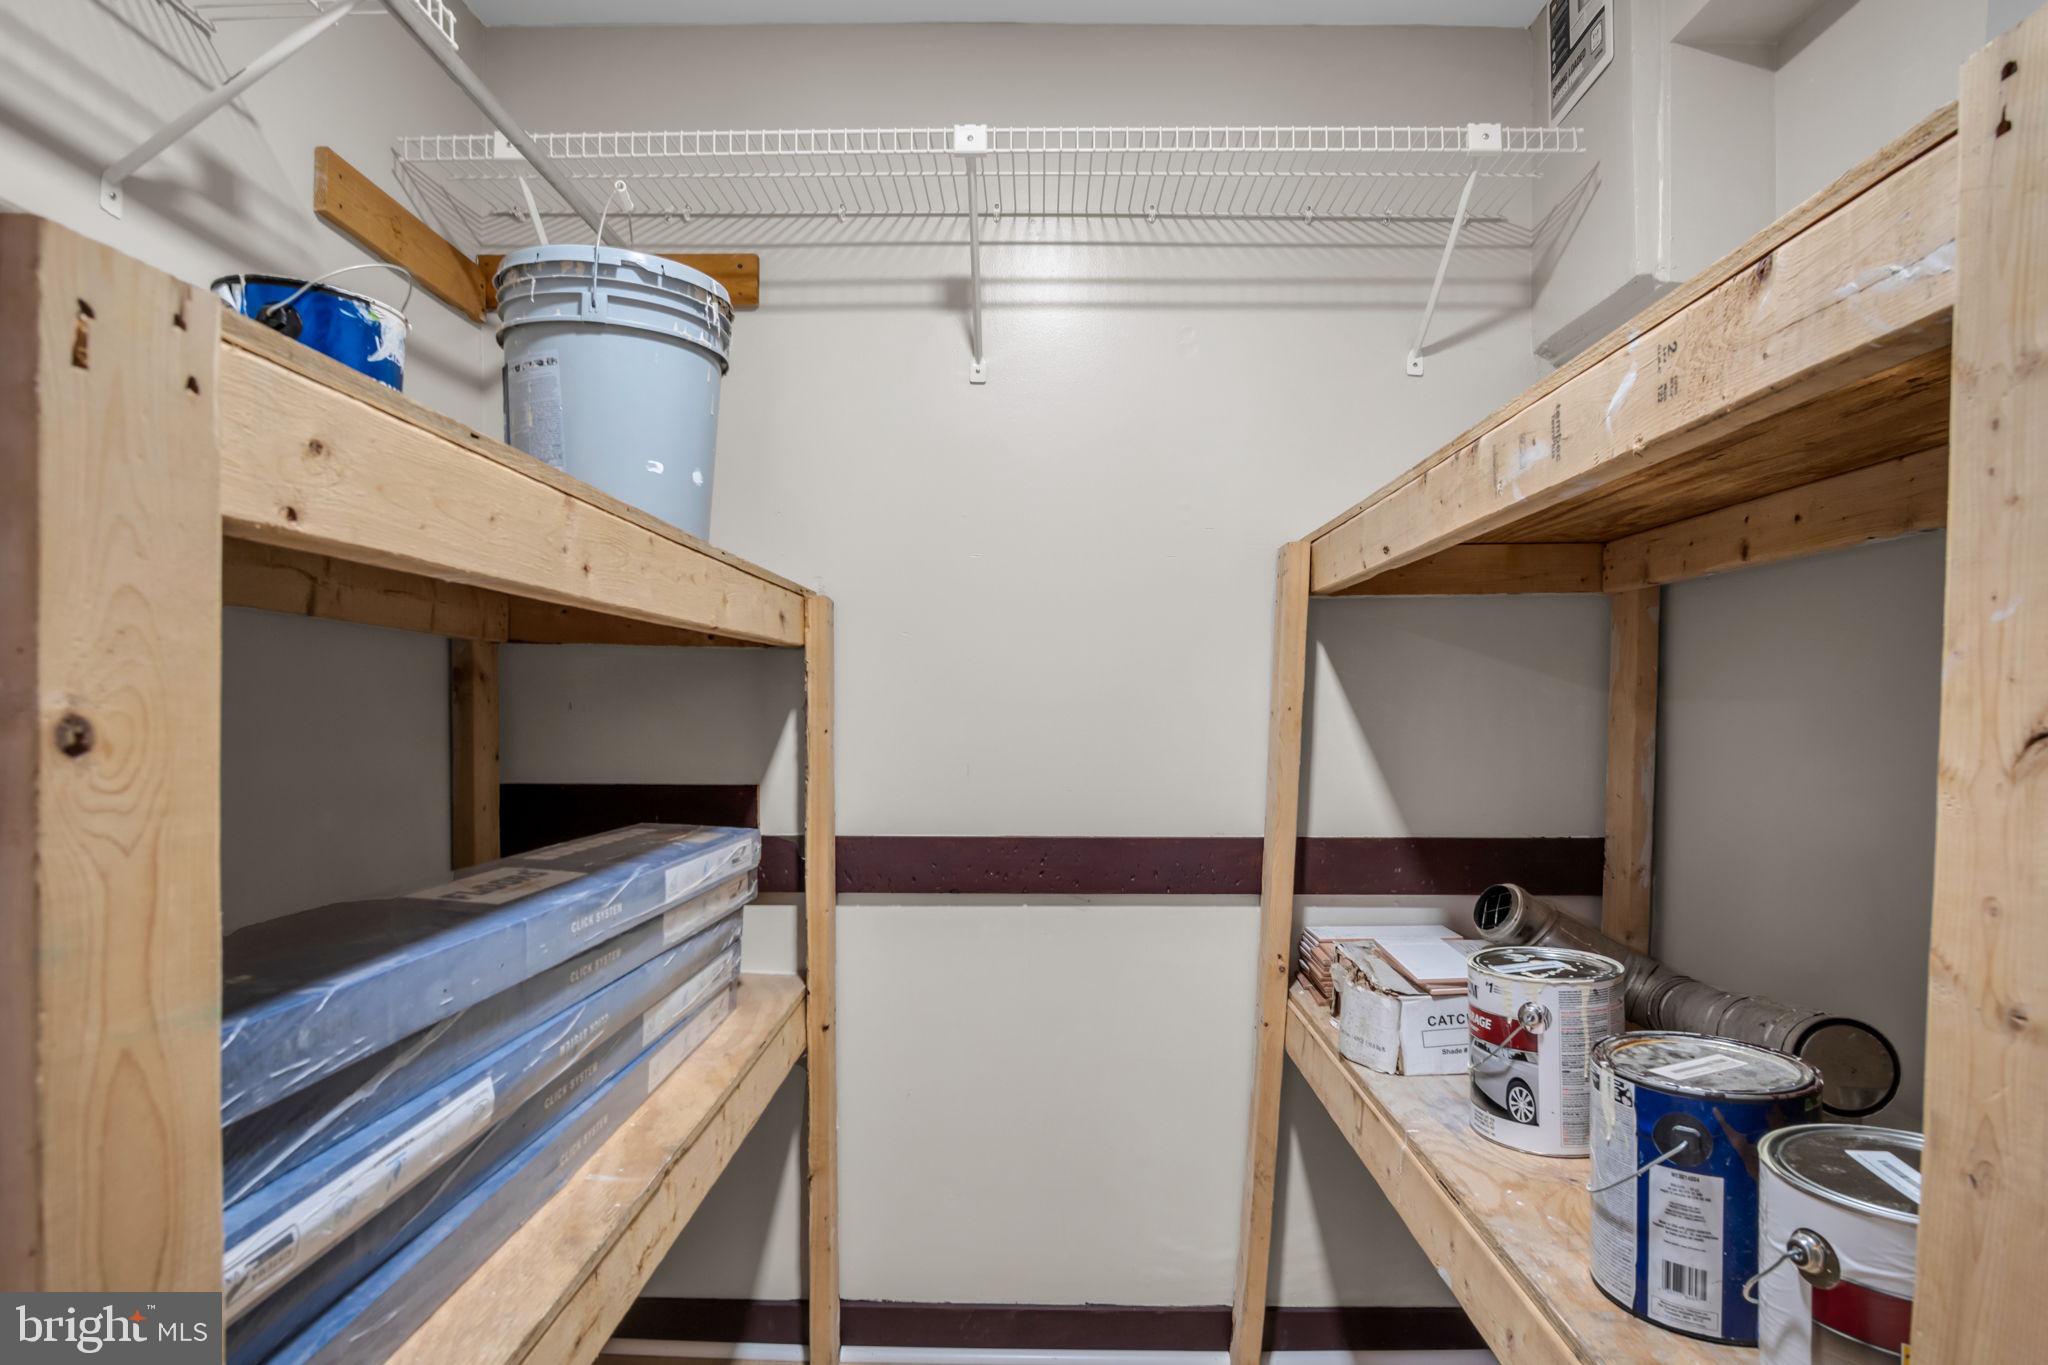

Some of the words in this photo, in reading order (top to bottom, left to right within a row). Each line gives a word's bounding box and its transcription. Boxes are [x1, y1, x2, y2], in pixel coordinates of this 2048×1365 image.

[570, 912, 594, 934] CLICK
[595, 902, 623, 923] SYSTEM
[569, 962, 593, 984] CLICK
